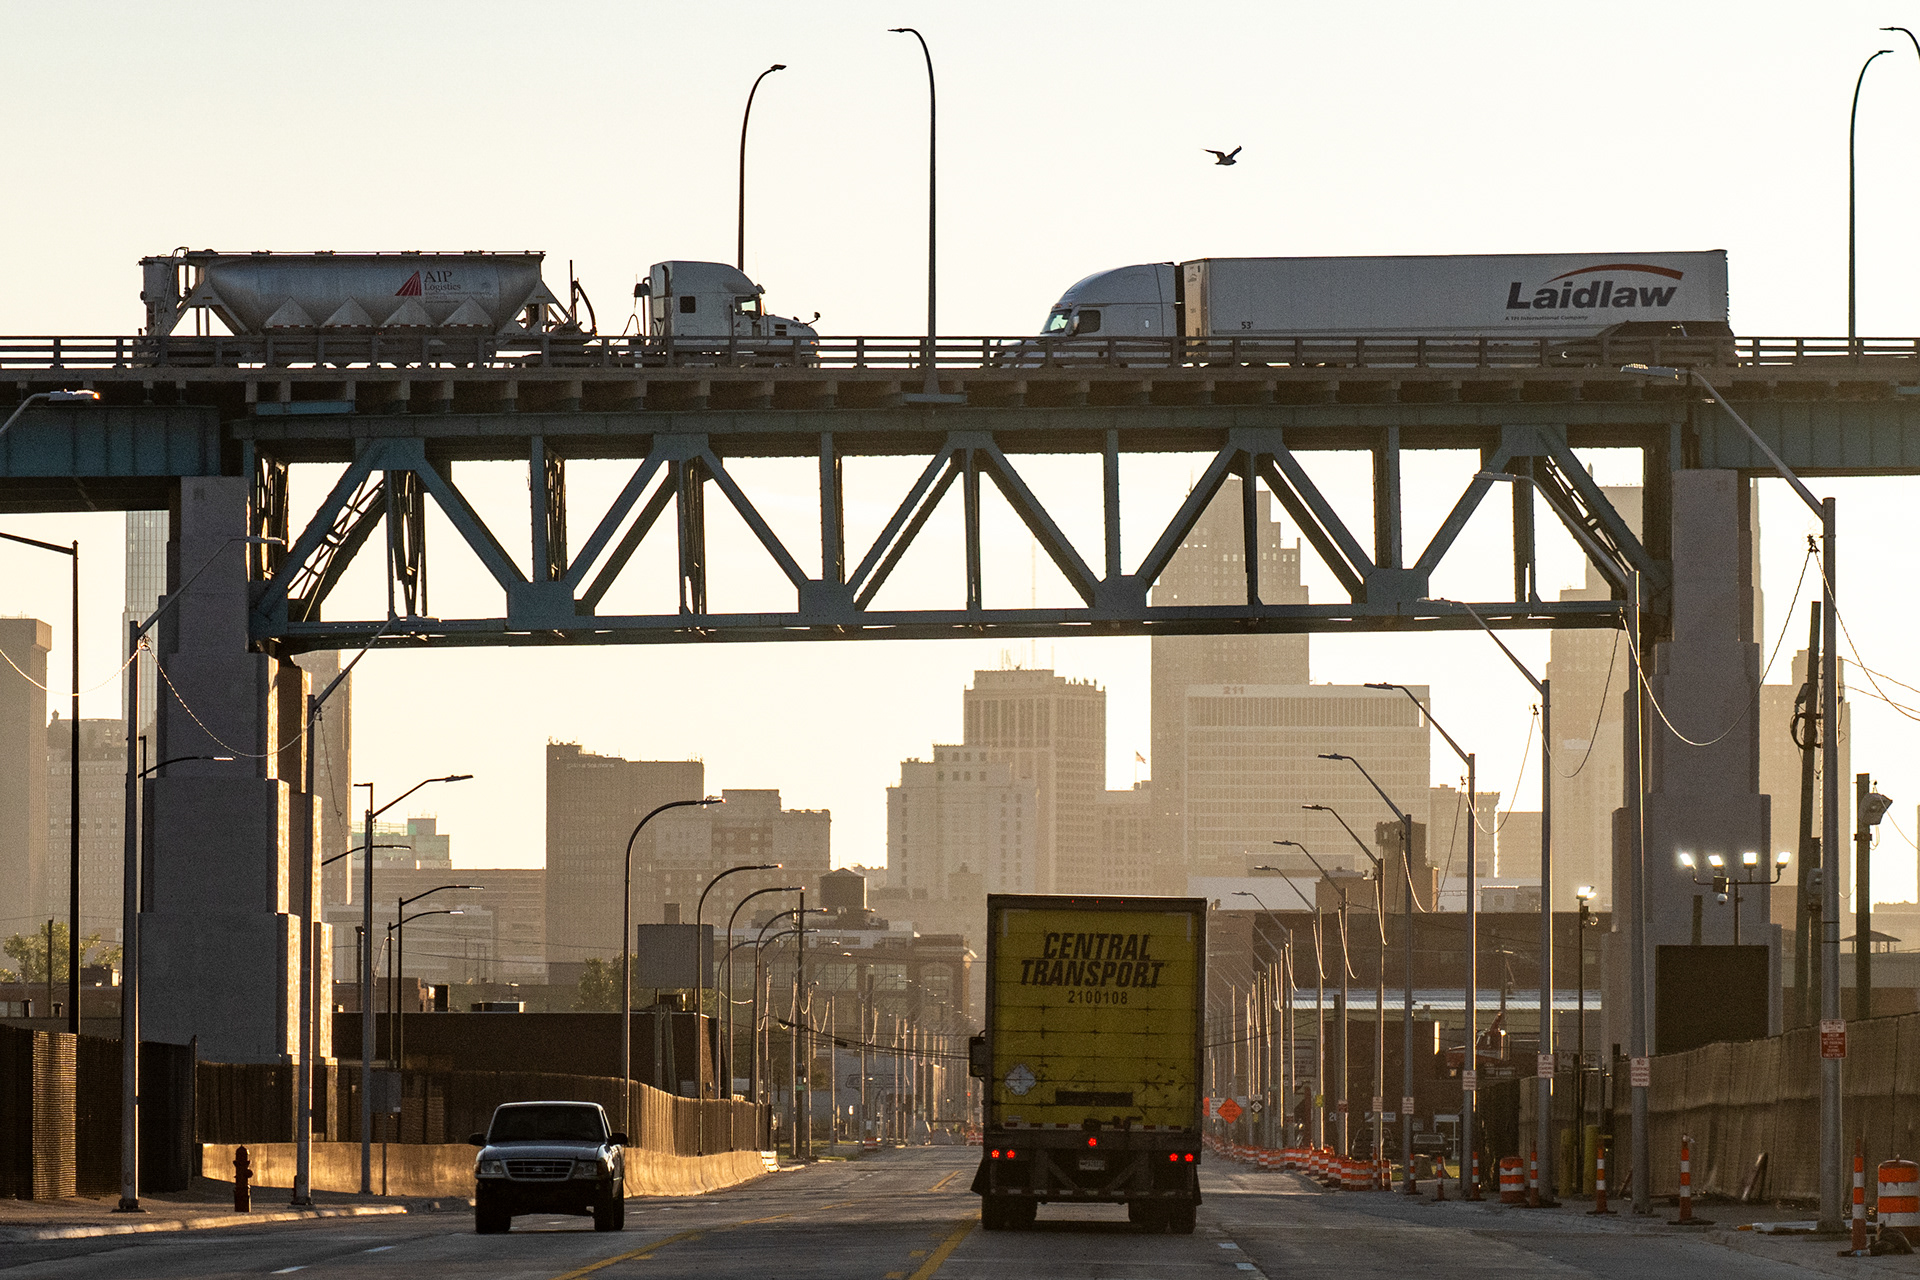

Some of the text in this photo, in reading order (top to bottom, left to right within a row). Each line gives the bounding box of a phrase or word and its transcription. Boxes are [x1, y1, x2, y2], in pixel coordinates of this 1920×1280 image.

[424, 270, 453, 283] AIP
[424, 283, 461, 292] Logistics
[1506, 281, 1677, 309] Laidlaw
[1223, 686, 1245, 695] 211
[1043, 932, 1150, 960] CENTRAL
[1020, 959, 1165, 988] TRANSPORT
[1068, 990, 1128, 1005] 2100108
